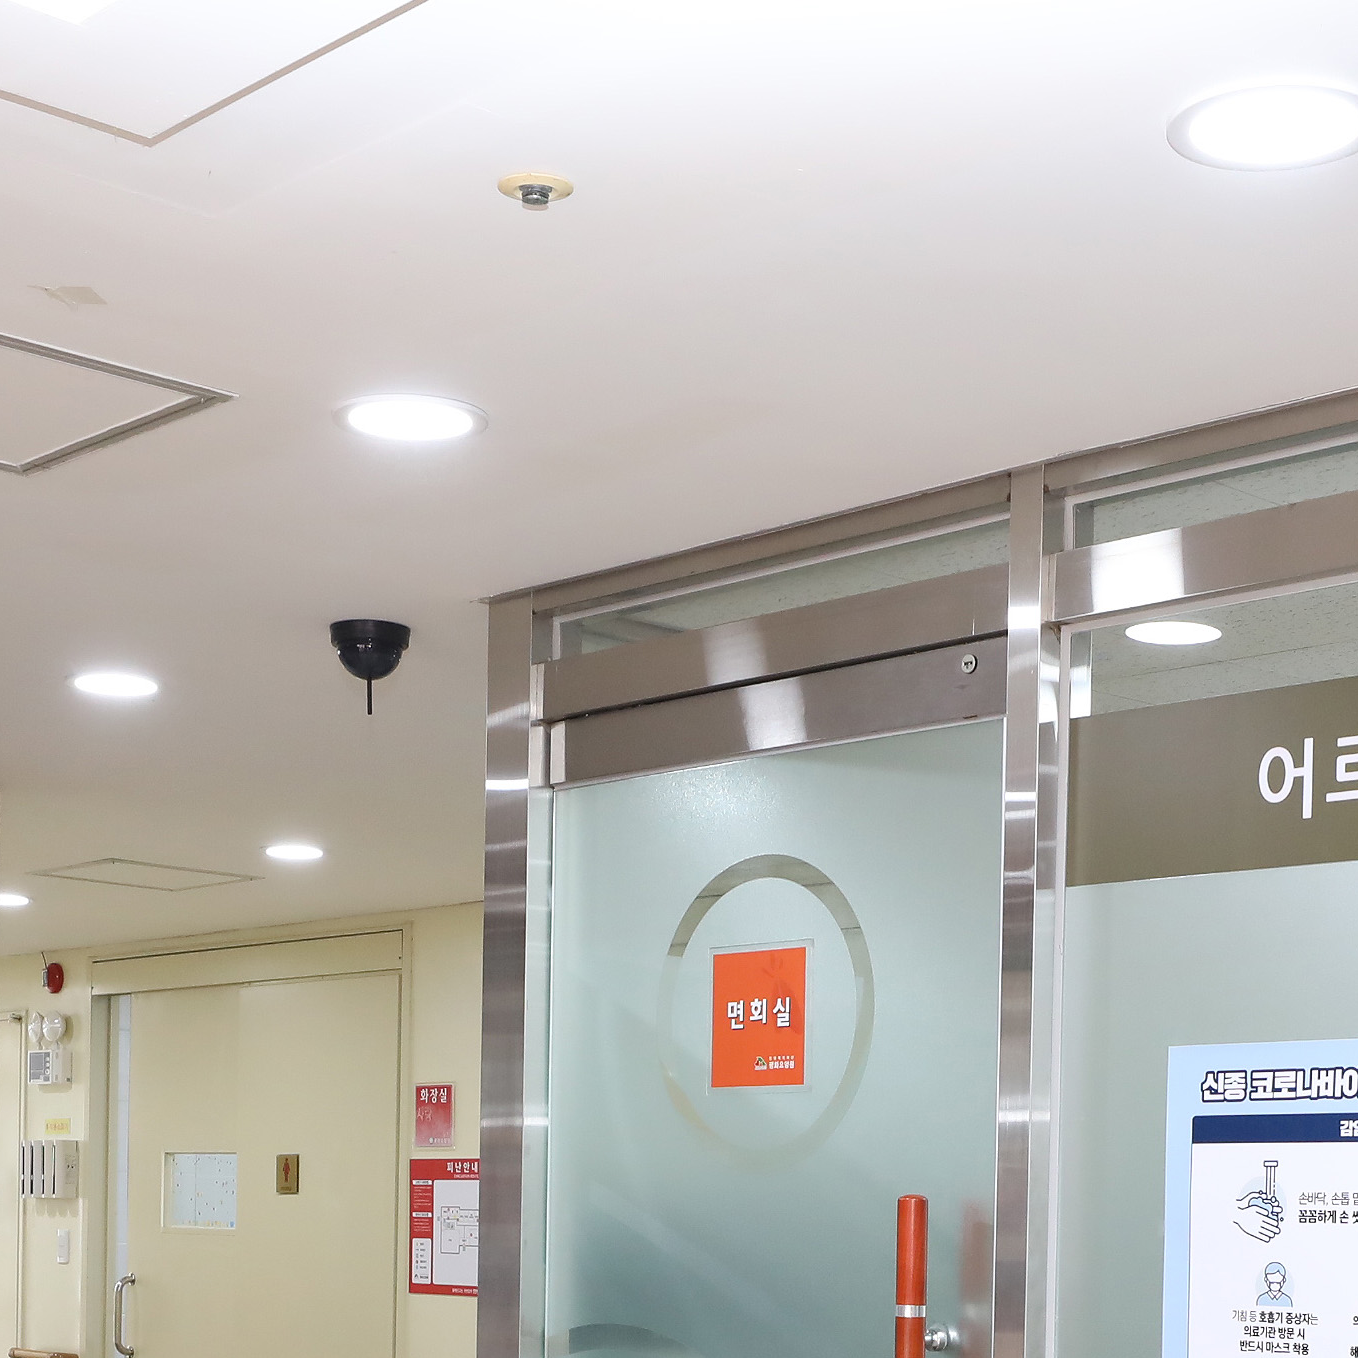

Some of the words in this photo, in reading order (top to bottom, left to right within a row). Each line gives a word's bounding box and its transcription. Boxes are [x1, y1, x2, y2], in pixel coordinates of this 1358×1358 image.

[727, 996, 792, 1030] 면회실
[1201, 1070, 1247, 1102] 신종
[420, 1088, 447, 1104] 화장실
[1299, 1192, 1329, 1206] 손바닥,
[1331, 1192, 1350, 1206] 손톱
[1299, 1209, 1337, 1224] 꼼꼼하게
[1339, 1210, 1349, 1224] 손
[1232, 1310, 1247, 1322] 기침
[1249, 1310, 1257, 1322] 등
[1259, 1310, 1283, 1324] 호흡기
[1285, 1312, 1319, 1326] 증상자는
[1243, 1326, 1276, 1339] 의료기관
[1278, 1327, 1295, 1340] 방문
[1297, 1328, 1305, 1340] 시
[1239, 1340, 1264, 1353] 반드시
[1265, 1341, 1291, 1354] 마스크
[1293, 1342, 1310, 1356] 착용
